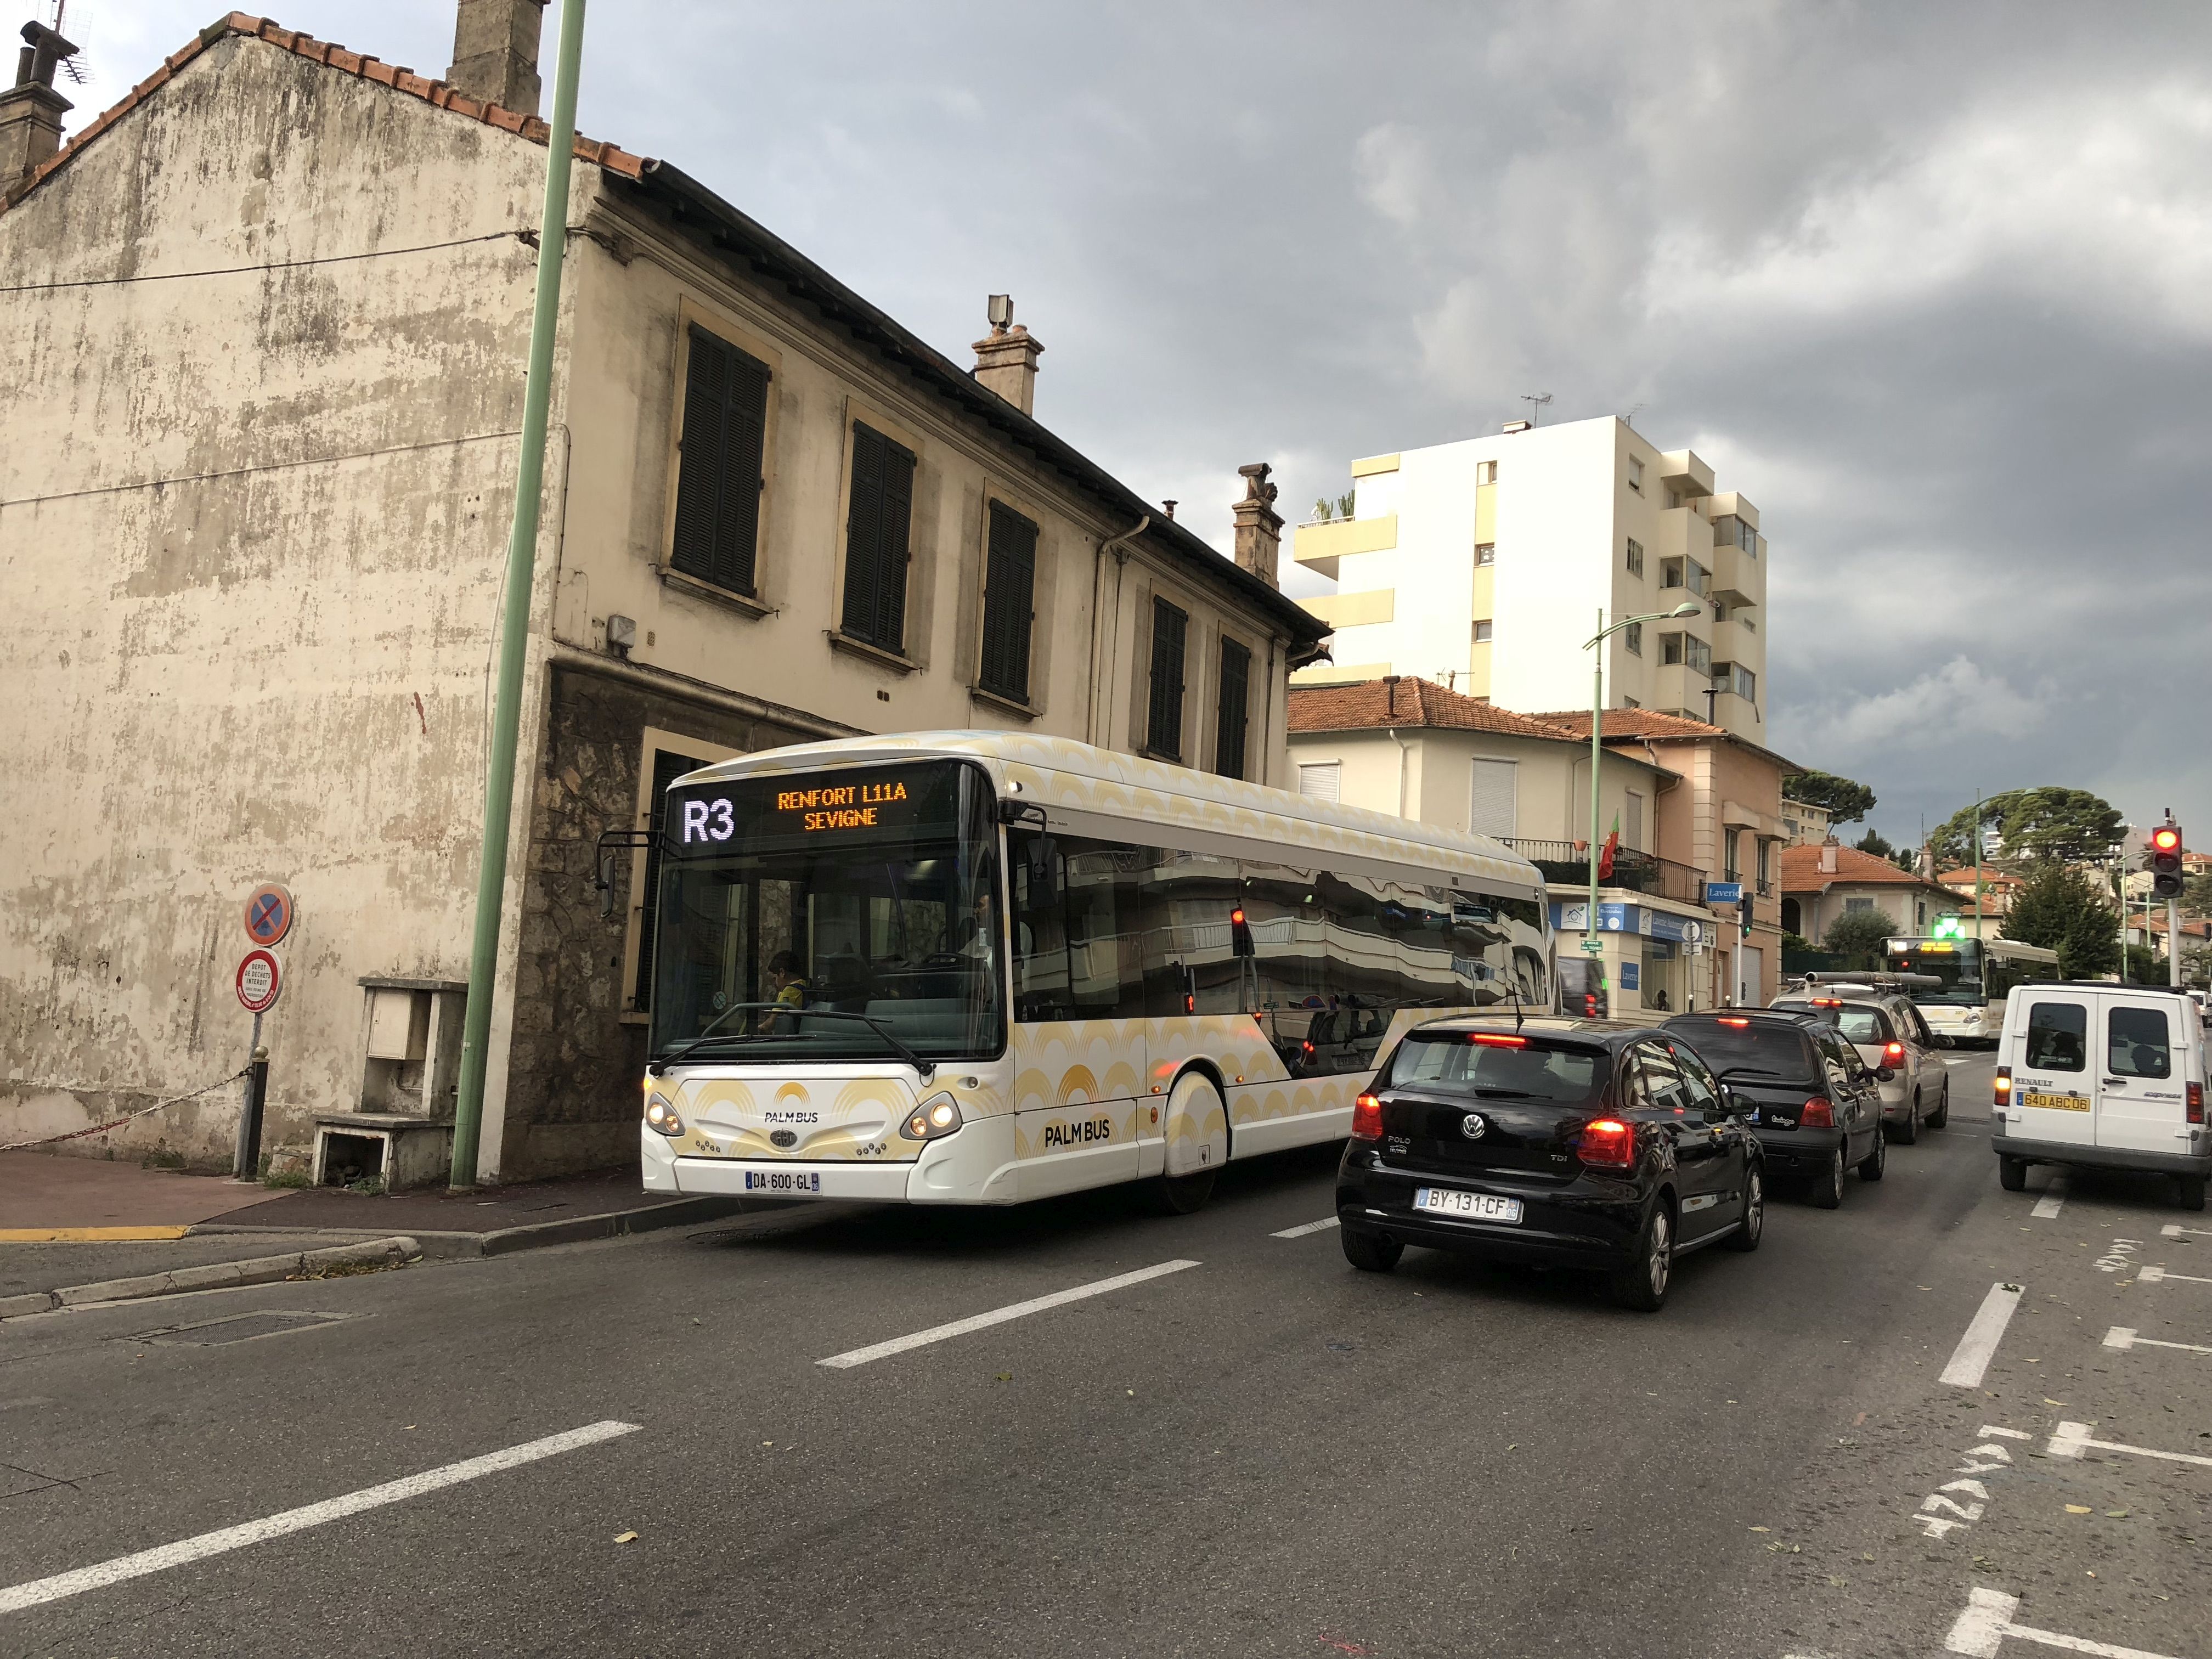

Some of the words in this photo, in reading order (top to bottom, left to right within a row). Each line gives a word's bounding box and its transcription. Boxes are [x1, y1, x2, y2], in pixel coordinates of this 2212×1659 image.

[778, 786, 856, 810] RENFORT
[862, 782, 907, 803] L11A
[684, 798, 735, 842] R3
[804, 808, 878, 831] SEVIGNE
[1709, 888, 1740, 897] Laverie
[2015, 1077, 2053, 1087] RENAULT
[2025, 1094, 2046, 1107] 640
[2049, 1097, 2070, 1108] ABC
[2073, 1099, 2087, 1110] 06
[765, 1112, 794, 1123] PALM
[795, 1112, 819, 1123] BUS
[1771, 1115, 1795, 1127] twingo
[1045, 1122, 1082, 1148] PALM
[1084, 1119, 1109, 1141] BUS
[1387, 1136, 1411, 1144] POLO
[753, 1173, 811, 1190] DA-600-GL
[1429, 1190, 1506, 1215] BY-131-CF
[1507, 1208, 1517, 1217] 06
